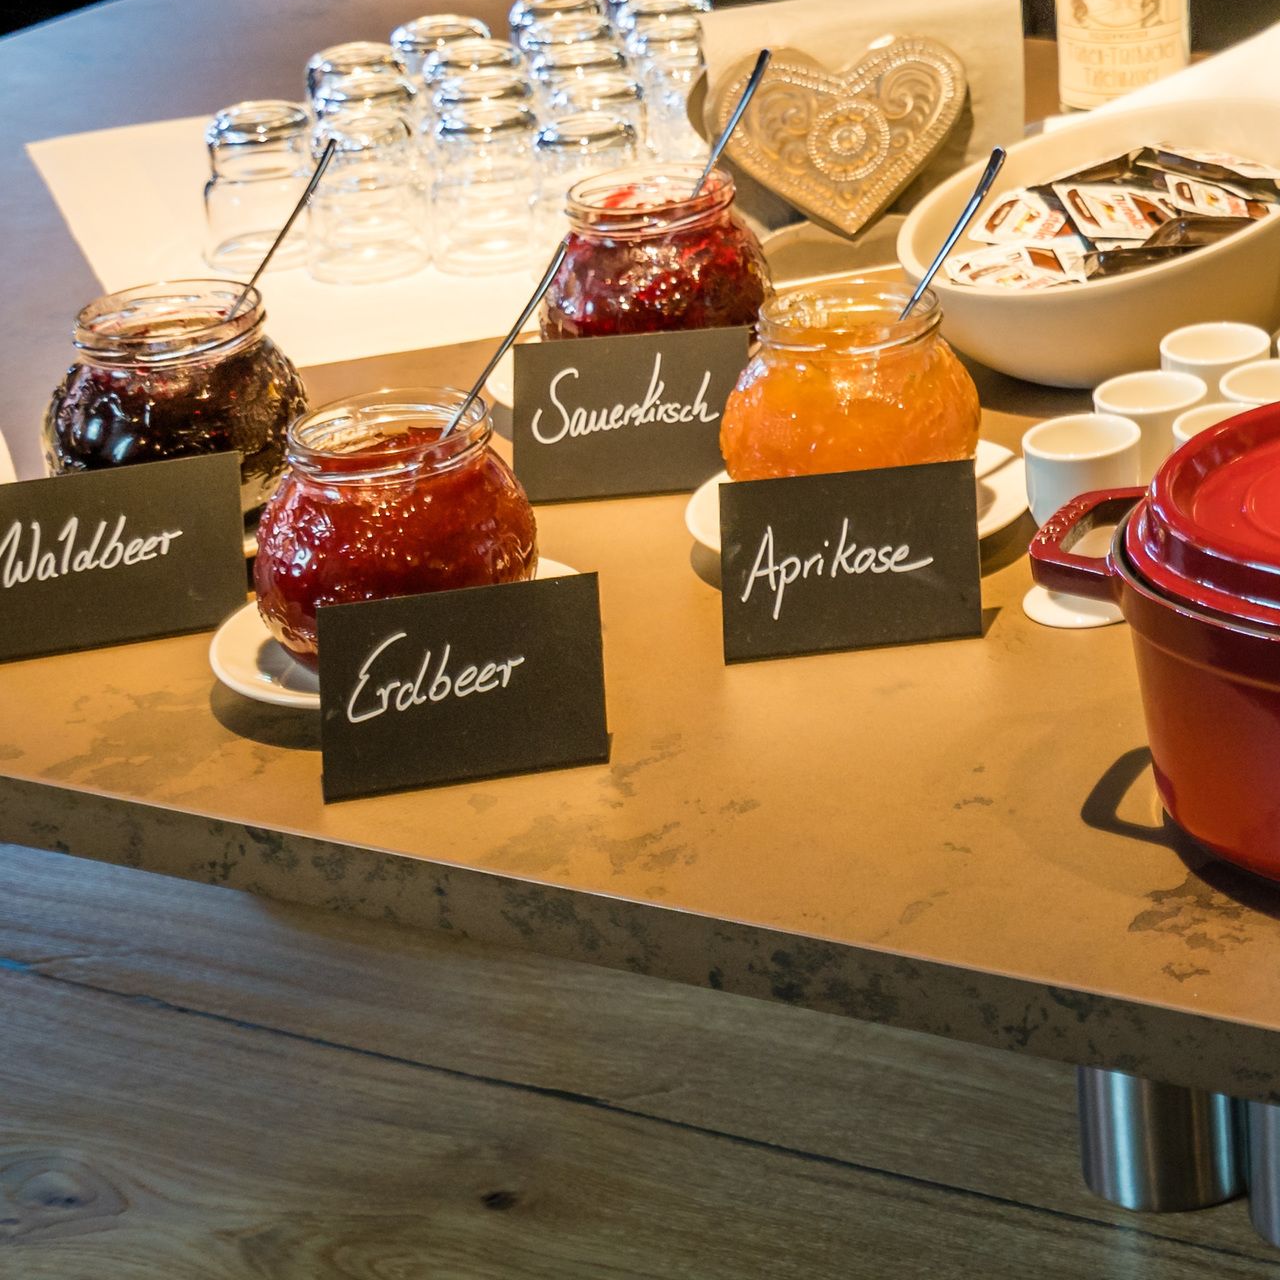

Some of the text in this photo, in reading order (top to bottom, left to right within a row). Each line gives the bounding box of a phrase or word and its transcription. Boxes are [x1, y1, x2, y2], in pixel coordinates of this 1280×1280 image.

[531, 352, 720, 445] Sauerkirsch
[0, 515, 184, 590] Waldbeer
[741, 518, 934, 620] Aprikose
[346, 631, 525, 725] Erdbeer
